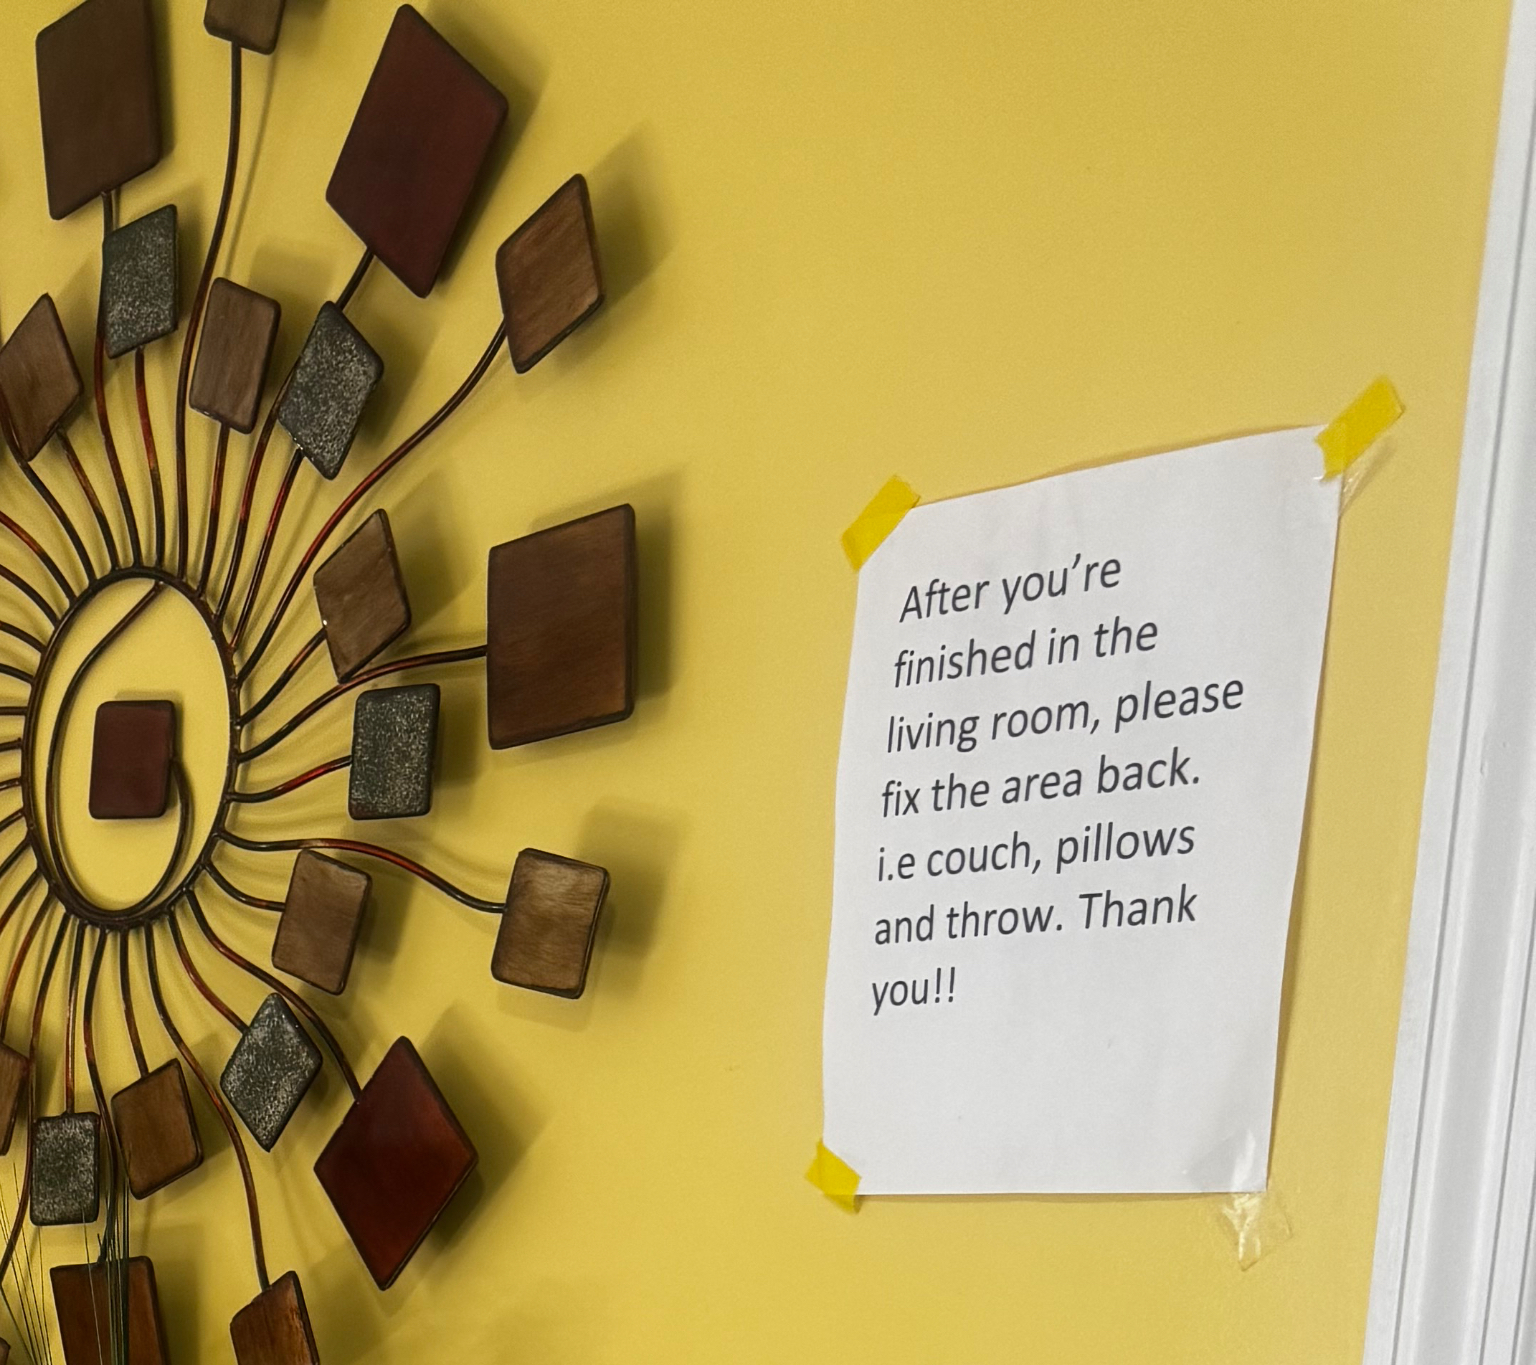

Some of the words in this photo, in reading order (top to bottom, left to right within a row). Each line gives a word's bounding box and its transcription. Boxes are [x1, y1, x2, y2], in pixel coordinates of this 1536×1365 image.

[898, 578, 991, 624] After
[1001, 552, 1122, 614] you're
[893, 629, 1037, 689] finished
[1047, 627, 1080, 666] in
[1093, 615, 1158, 658] the
[887, 711, 981, 754] living
[991, 700, 1100, 741] room,
[1114, 679, 1244, 734] please
[881, 779, 921, 818] fix
[930, 772, 990, 812] the
[1001, 768, 1083, 805] area
[1096, 745, 1200, 794] back.
[878, 846, 916, 882] i.e
[926, 830, 1041, 877] couch,
[1055, 821, 1196, 875] pillows
[874, 903, 935, 946] and
[945, 900, 1063, 940] throw.
[1078, 882, 1198, 930] Thank
[871, 966, 956, 1017] you!!
